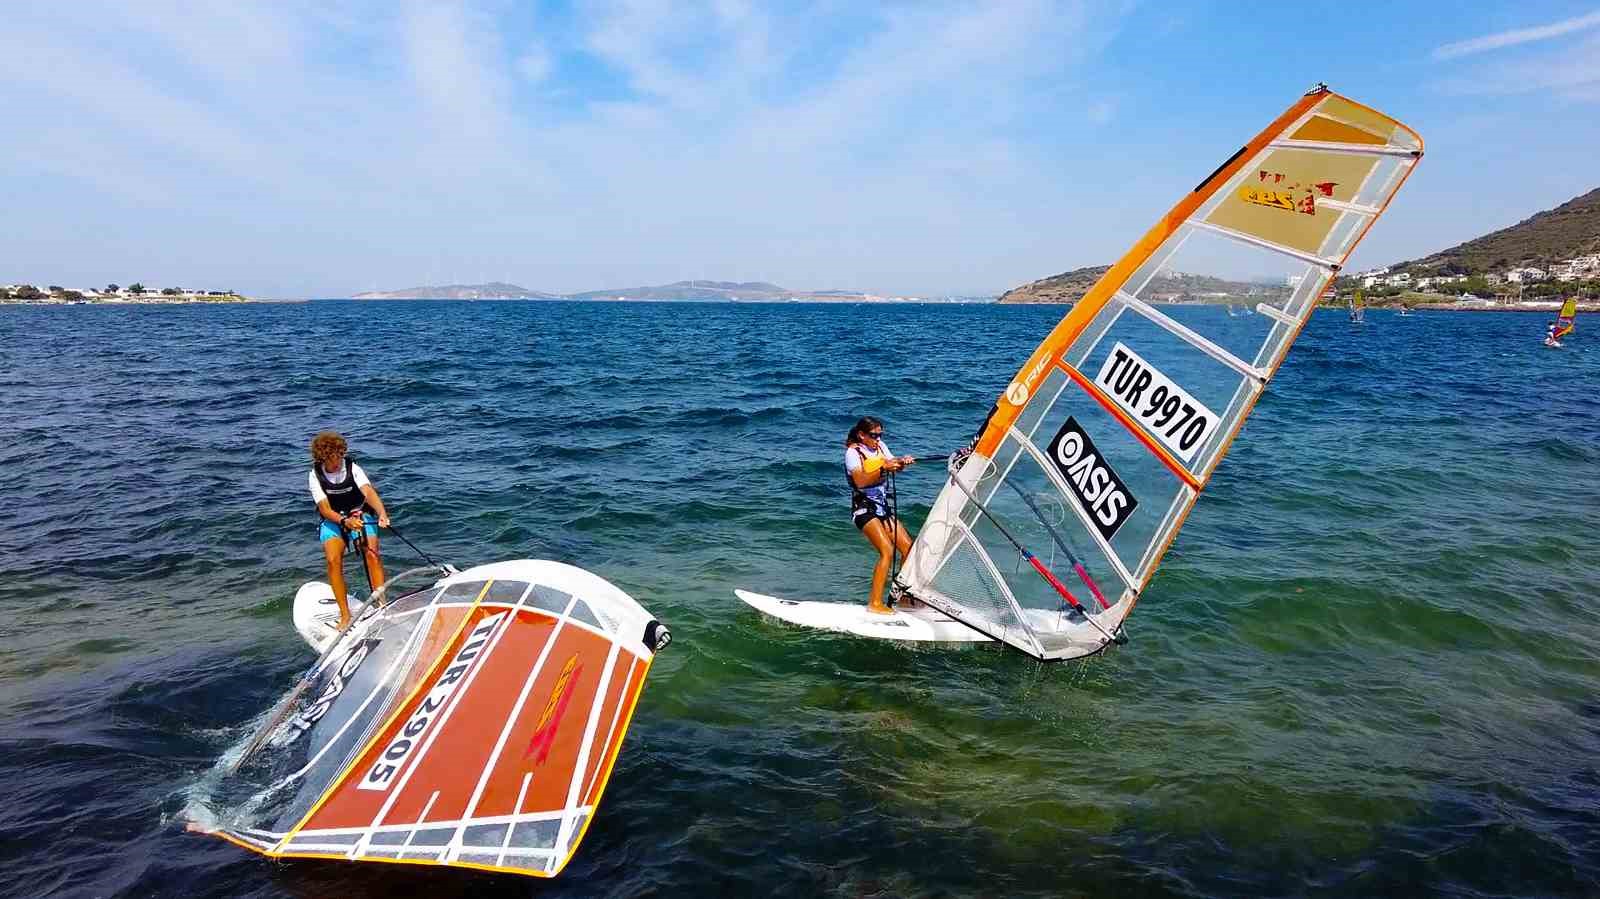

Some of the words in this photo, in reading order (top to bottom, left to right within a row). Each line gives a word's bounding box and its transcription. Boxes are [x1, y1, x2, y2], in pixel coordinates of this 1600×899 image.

[1104, 349, 1153, 409] TUR
[1141, 386, 1208, 451] 9970
[1057, 431, 1127, 527] OASIS
[435, 616, 502, 688] TUR
[368, 695, 443, 784] 2905
